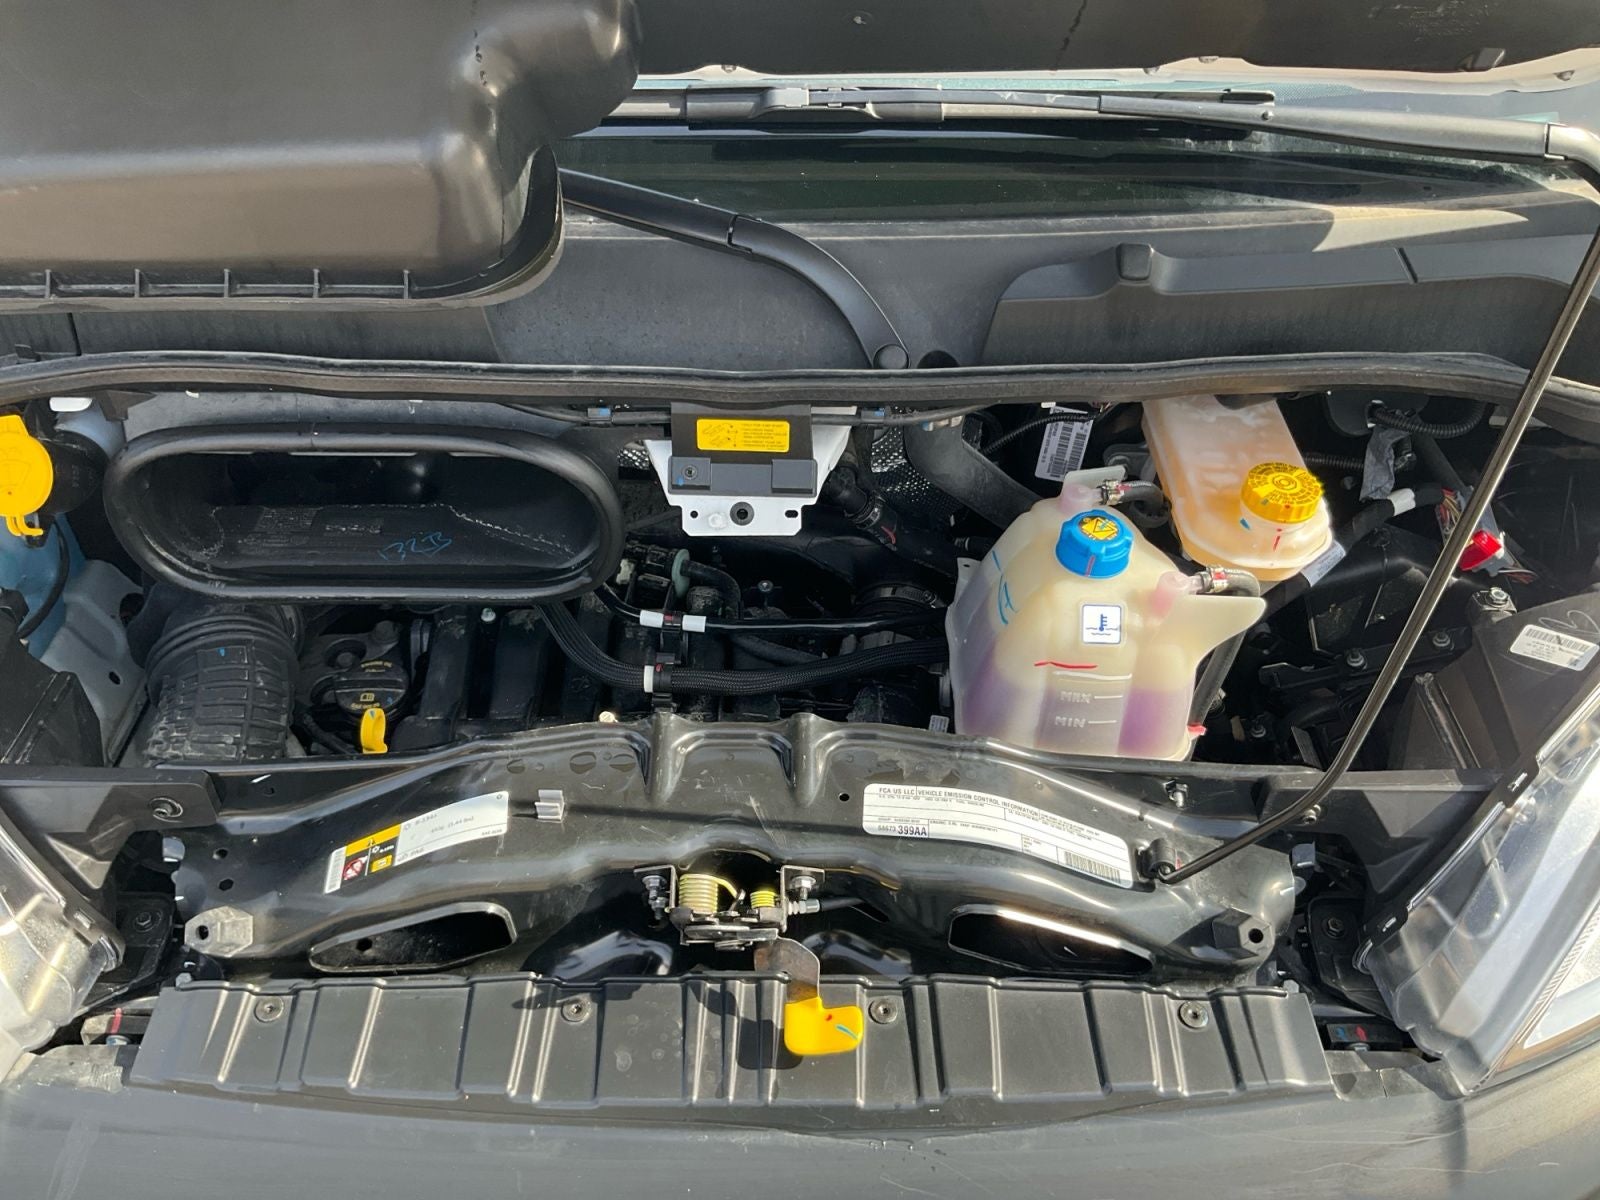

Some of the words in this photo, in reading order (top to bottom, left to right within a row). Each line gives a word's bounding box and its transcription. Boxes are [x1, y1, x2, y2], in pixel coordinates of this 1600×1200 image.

[1055, 715, 1087, 728] MIN
[917, 789, 943, 797] VEHICLE
[944, 791, 972, 800] EMISSION
[973, 794, 1001, 805] CONTROL
[1001, 801, 1039, 816] INFORMATION
[897, 825, 928, 836] 399AA
